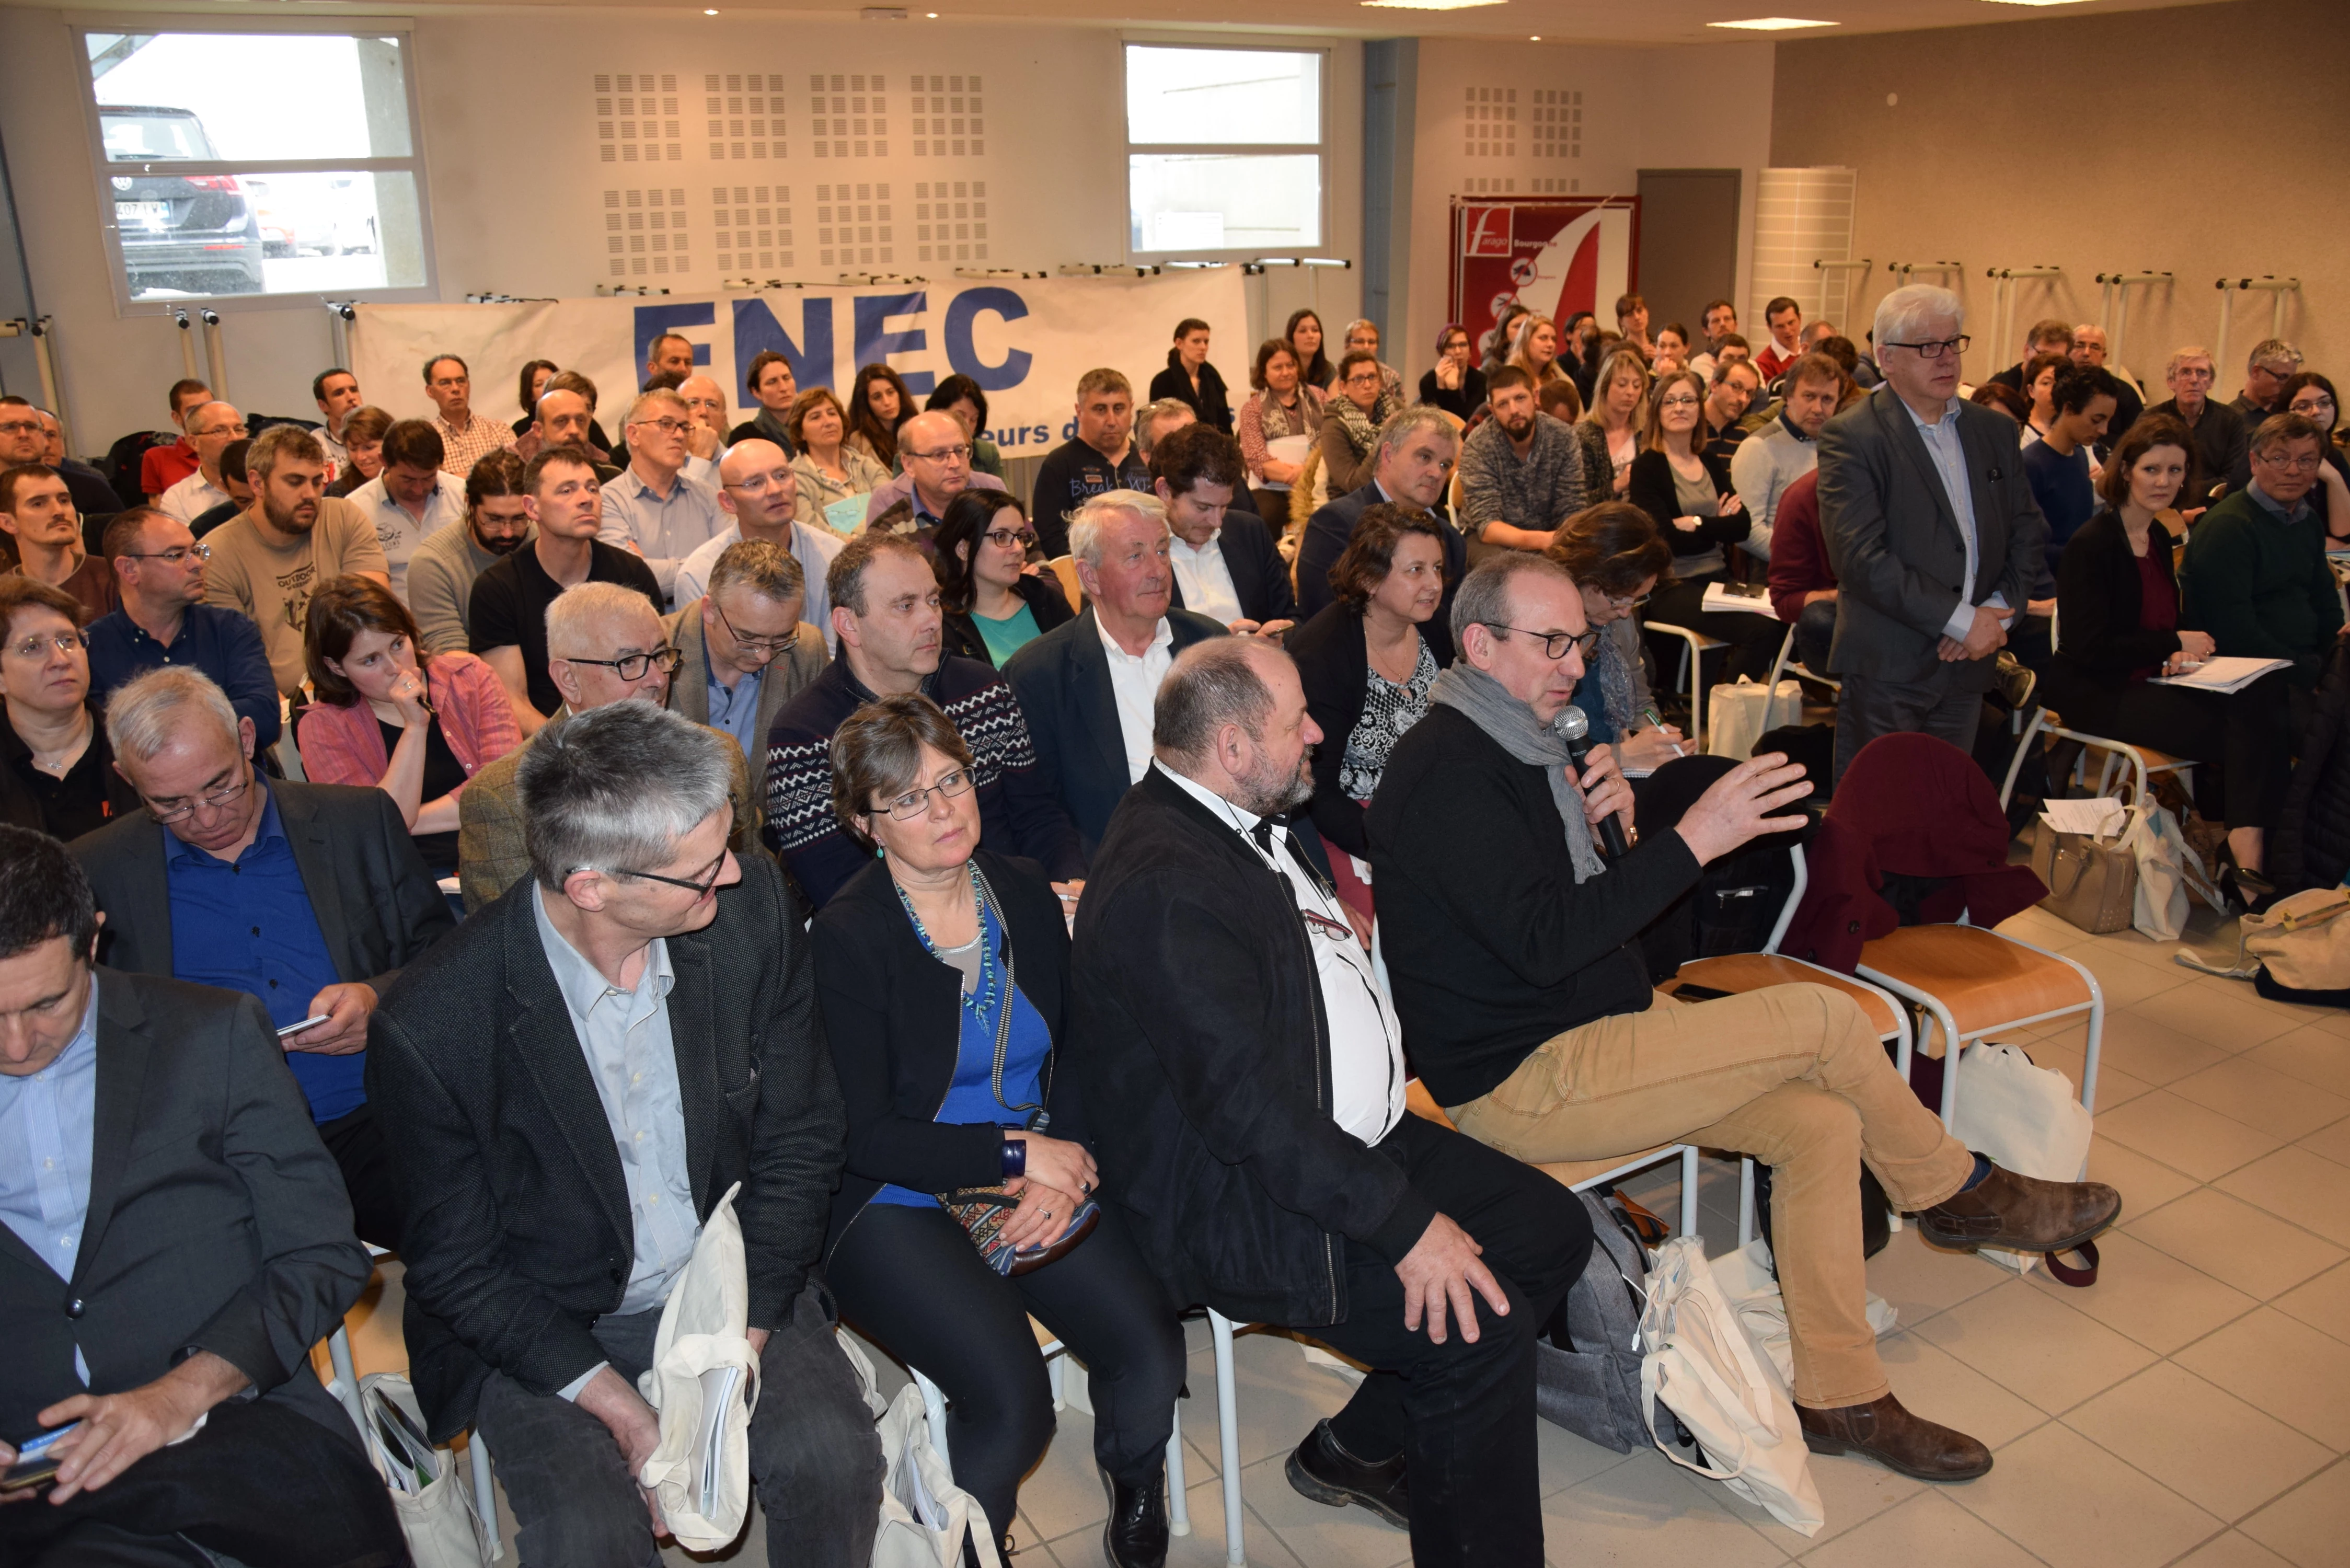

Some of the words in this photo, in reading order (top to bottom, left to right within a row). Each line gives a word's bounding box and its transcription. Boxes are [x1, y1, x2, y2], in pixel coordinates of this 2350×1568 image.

[980, 424, 1050, 447] eurs
[1069, 476, 1113, 497] Break
[278, 566, 316, 587] OUTDOOR
